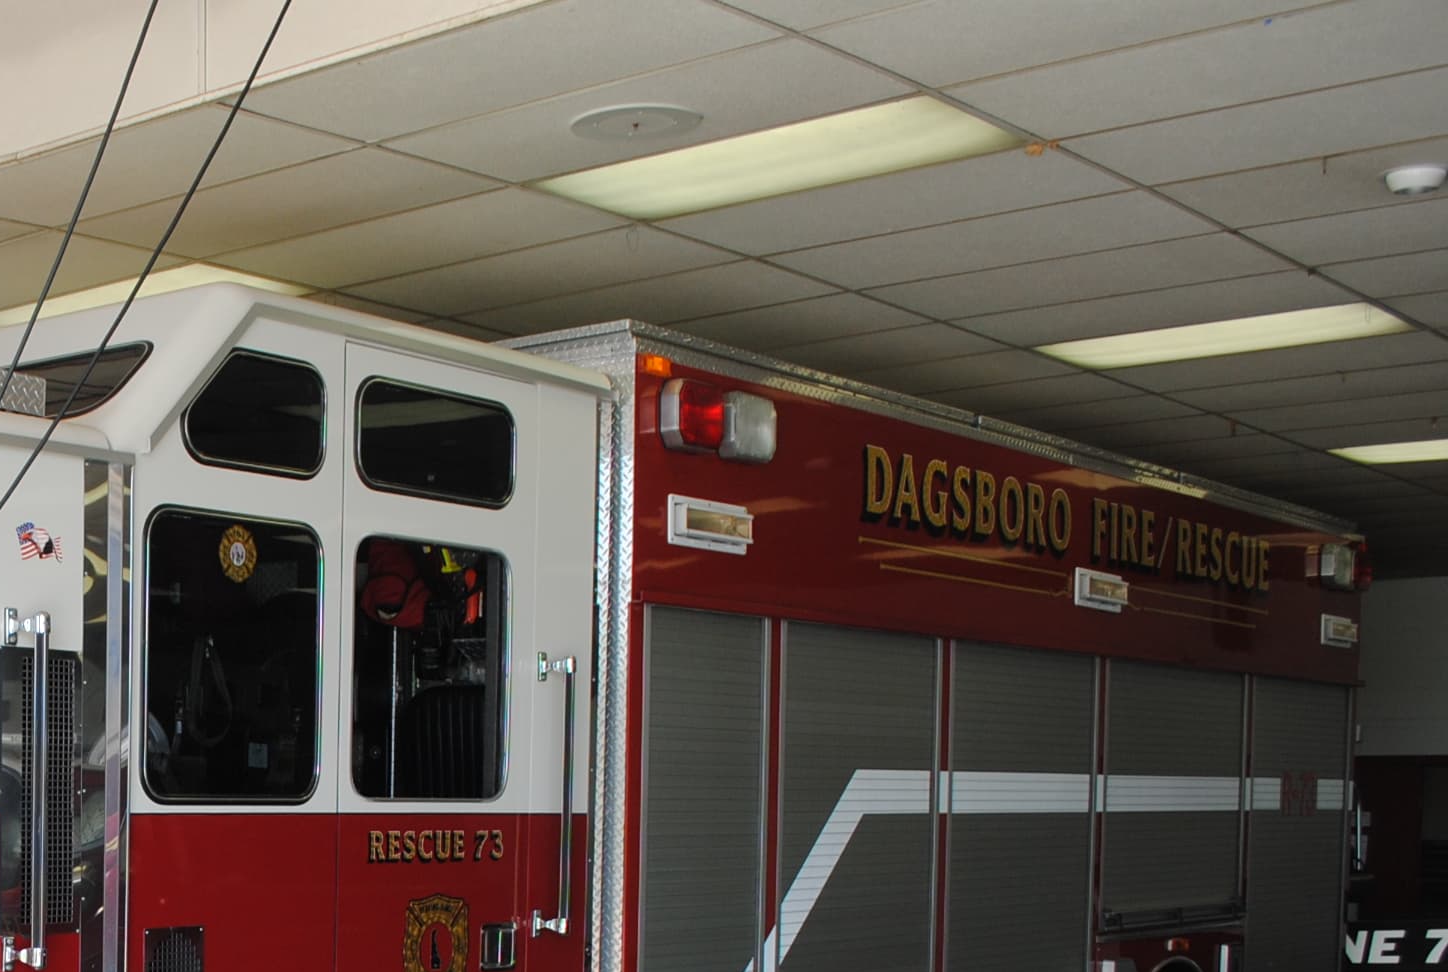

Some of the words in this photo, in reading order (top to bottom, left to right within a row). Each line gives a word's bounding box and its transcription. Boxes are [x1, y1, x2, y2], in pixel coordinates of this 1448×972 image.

[863, 442, 1072, 553] DAGSBORO
[368, 829, 465, 862] RESCUE
[474, 829, 504, 862] 73
